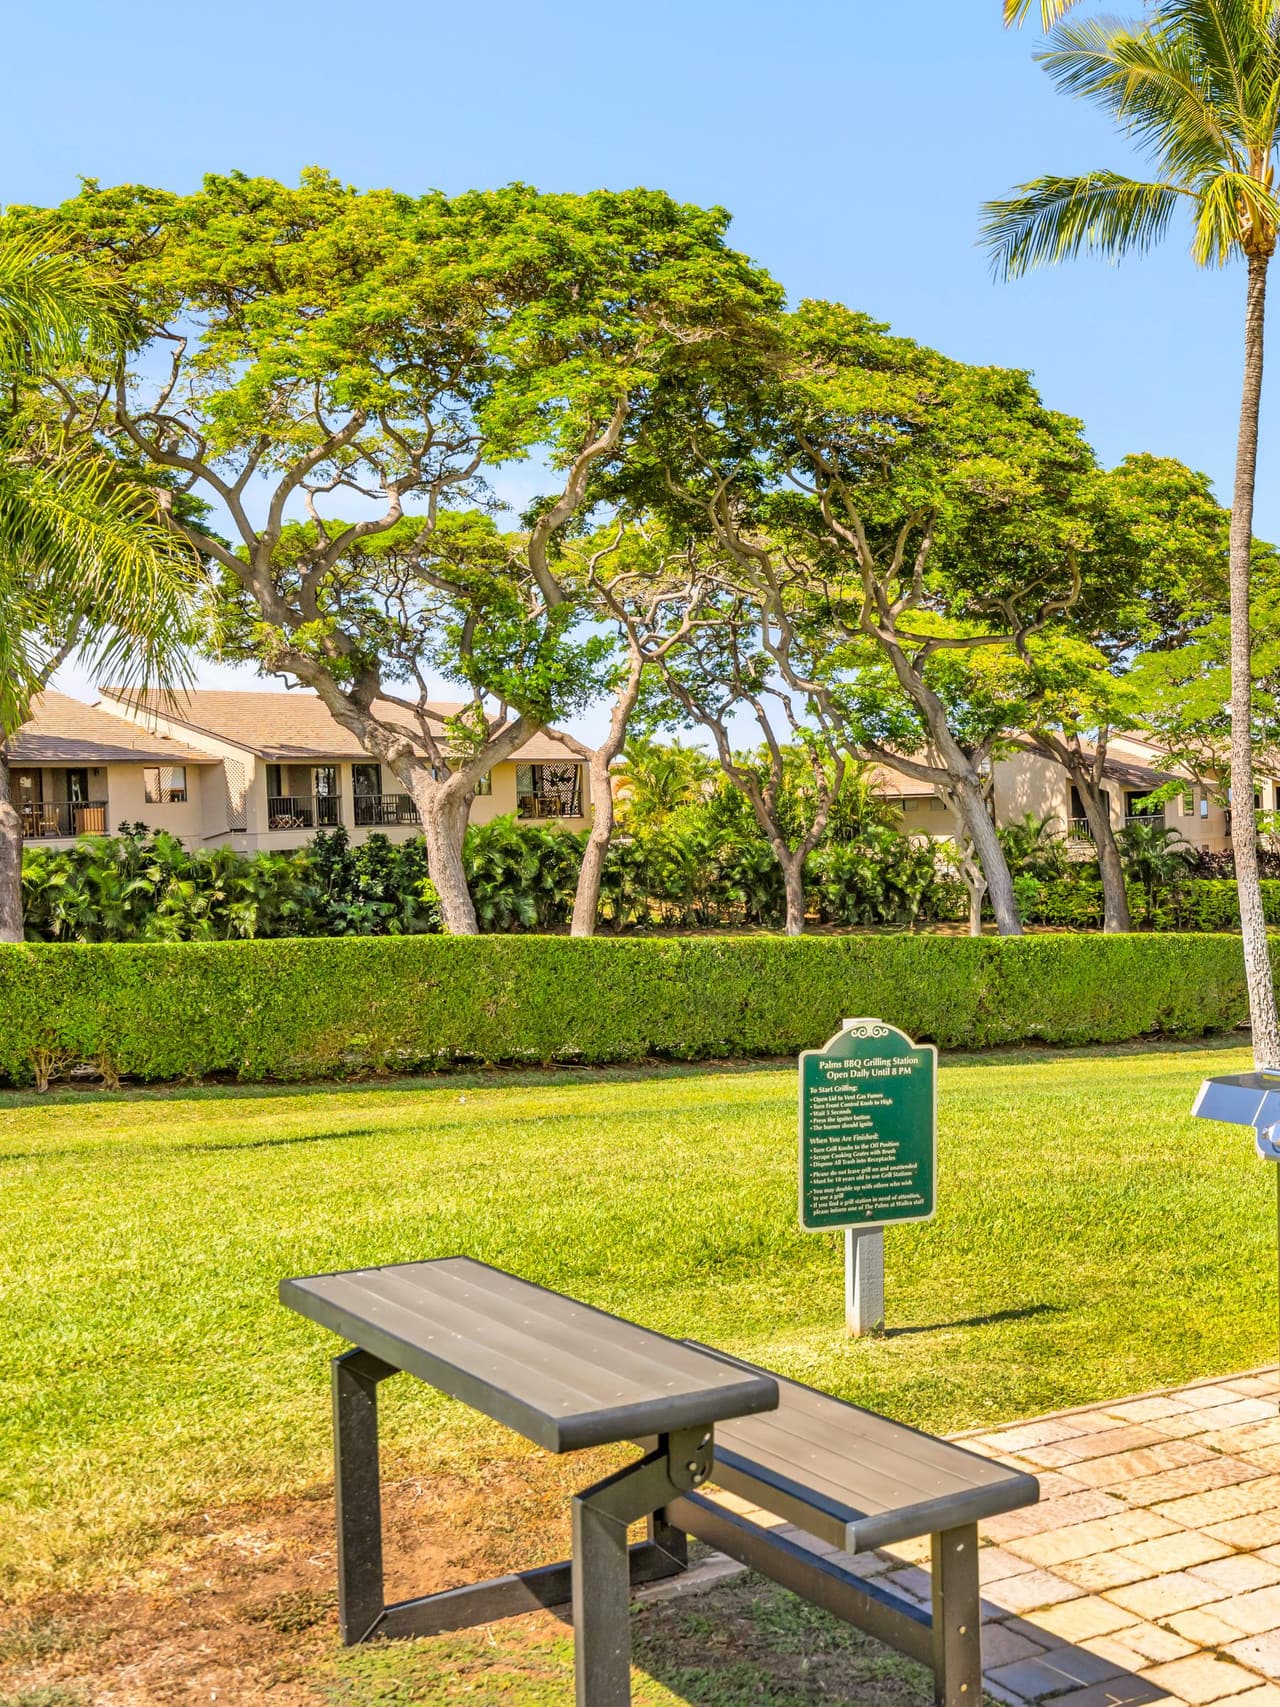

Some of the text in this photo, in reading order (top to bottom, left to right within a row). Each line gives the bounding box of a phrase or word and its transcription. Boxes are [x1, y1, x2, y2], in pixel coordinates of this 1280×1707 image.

[819, 1056, 918, 1069] Palms BBQ Grilling Station
[827, 1071, 848, 1080] Open
[850, 1070, 869, 1078] Daily
[872, 1068, 890, 1076] Until
